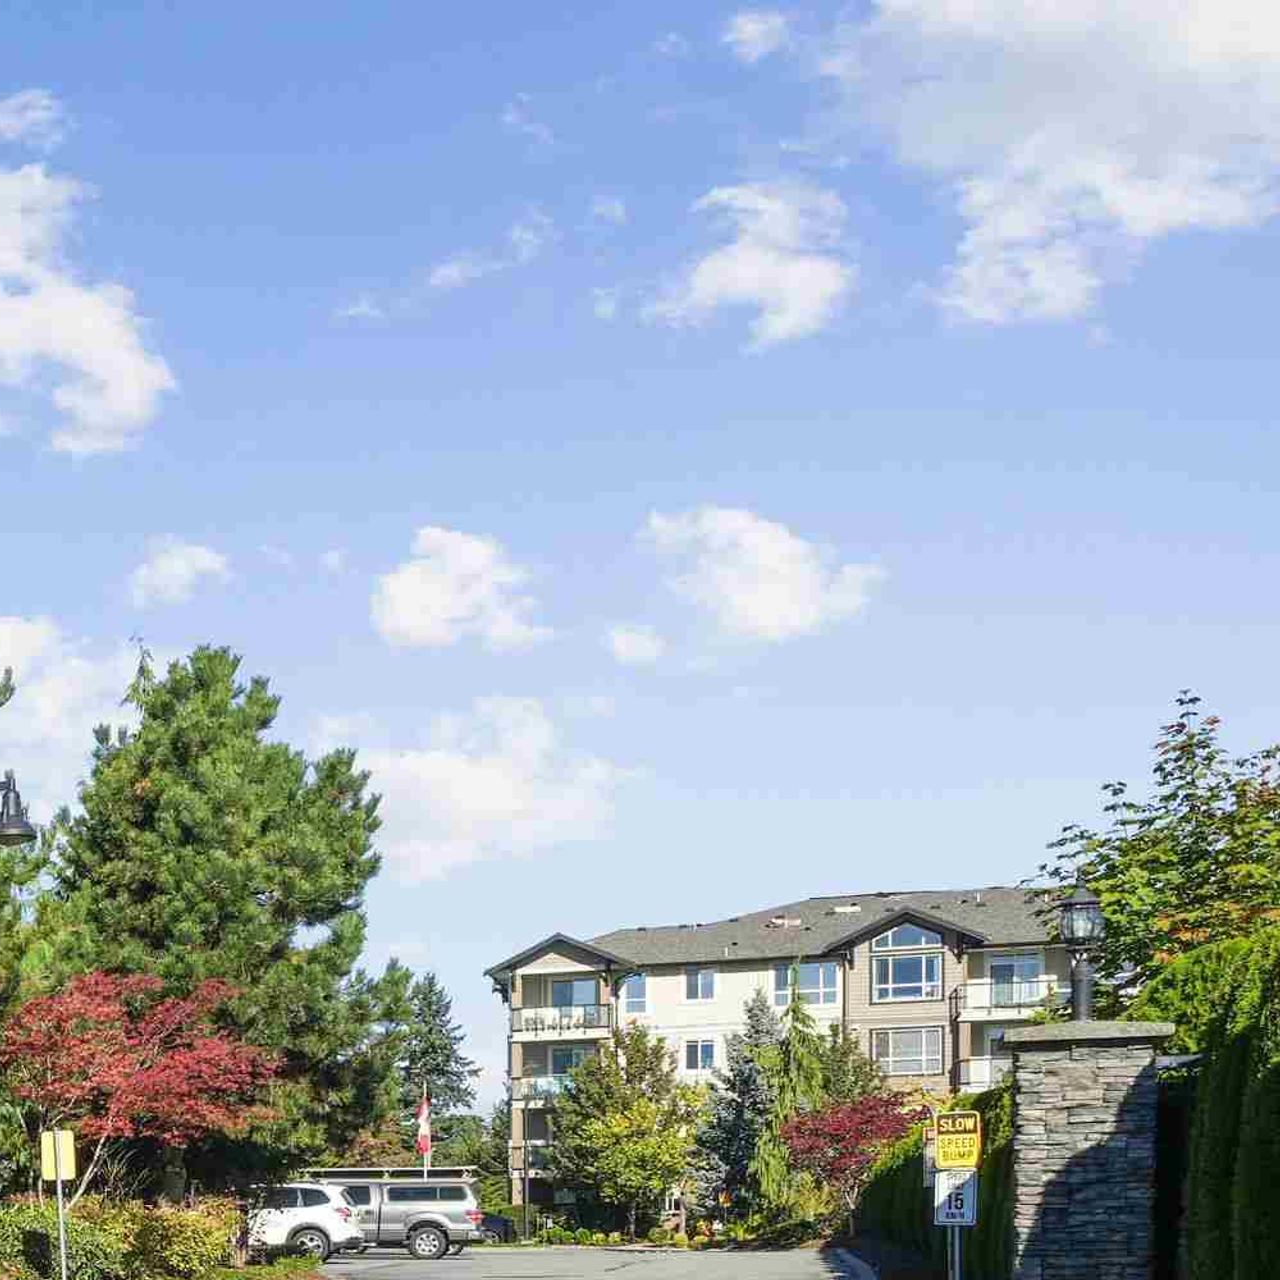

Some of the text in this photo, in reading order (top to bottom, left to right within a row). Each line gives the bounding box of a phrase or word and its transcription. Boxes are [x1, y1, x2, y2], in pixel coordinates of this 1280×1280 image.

[940, 1117, 975, 1131] SLOW
[940, 1137, 975, 1149] SPEED
[942, 1149, 974, 1161] BUMP
[947, 1192, 964, 1210] 15
